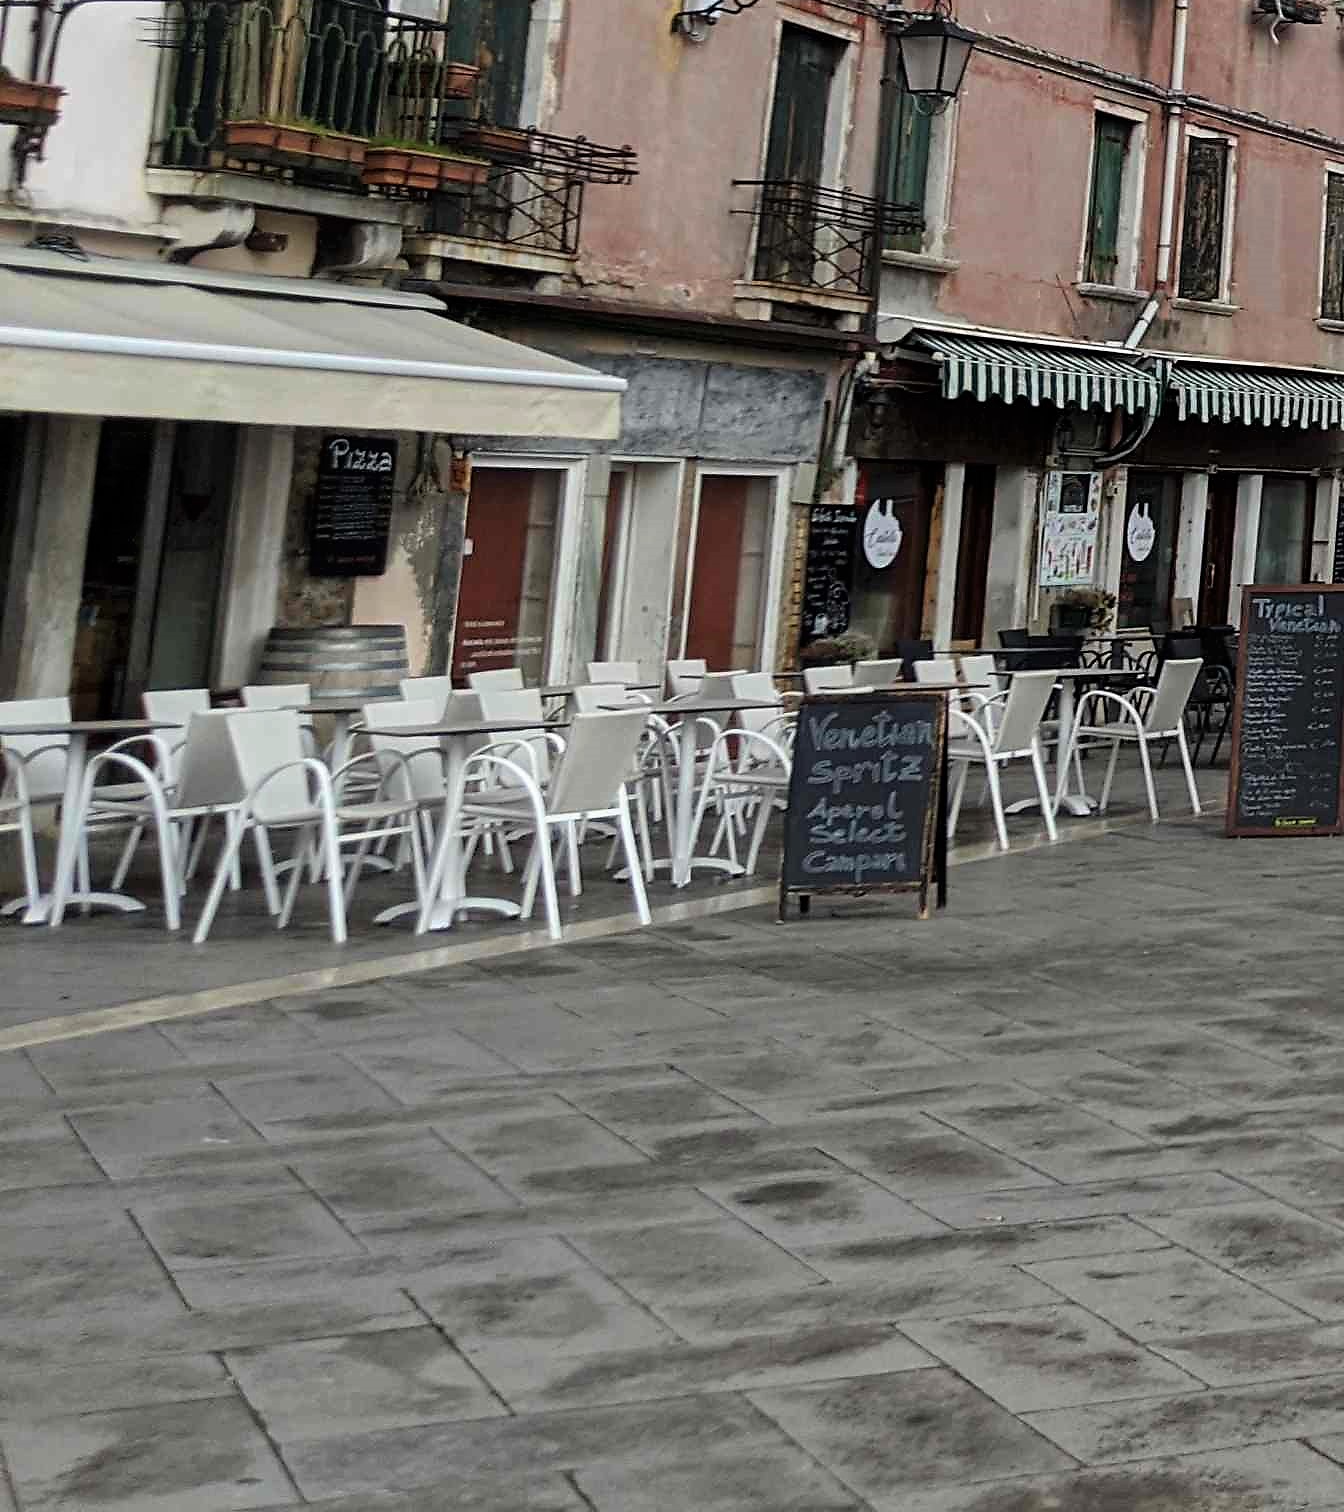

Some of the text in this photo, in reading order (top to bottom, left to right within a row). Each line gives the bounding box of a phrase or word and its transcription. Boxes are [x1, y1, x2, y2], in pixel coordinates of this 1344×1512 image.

[329, 438, 392, 472] Pizza
[1252, 594, 1325, 618] Typical
[808, 710, 933, 751] Venetian
[807, 750, 924, 794] Spritz
[805, 790, 904, 826] Aperol
[808, 819, 906, 844] Select
[802, 849, 906, 883] Campari
